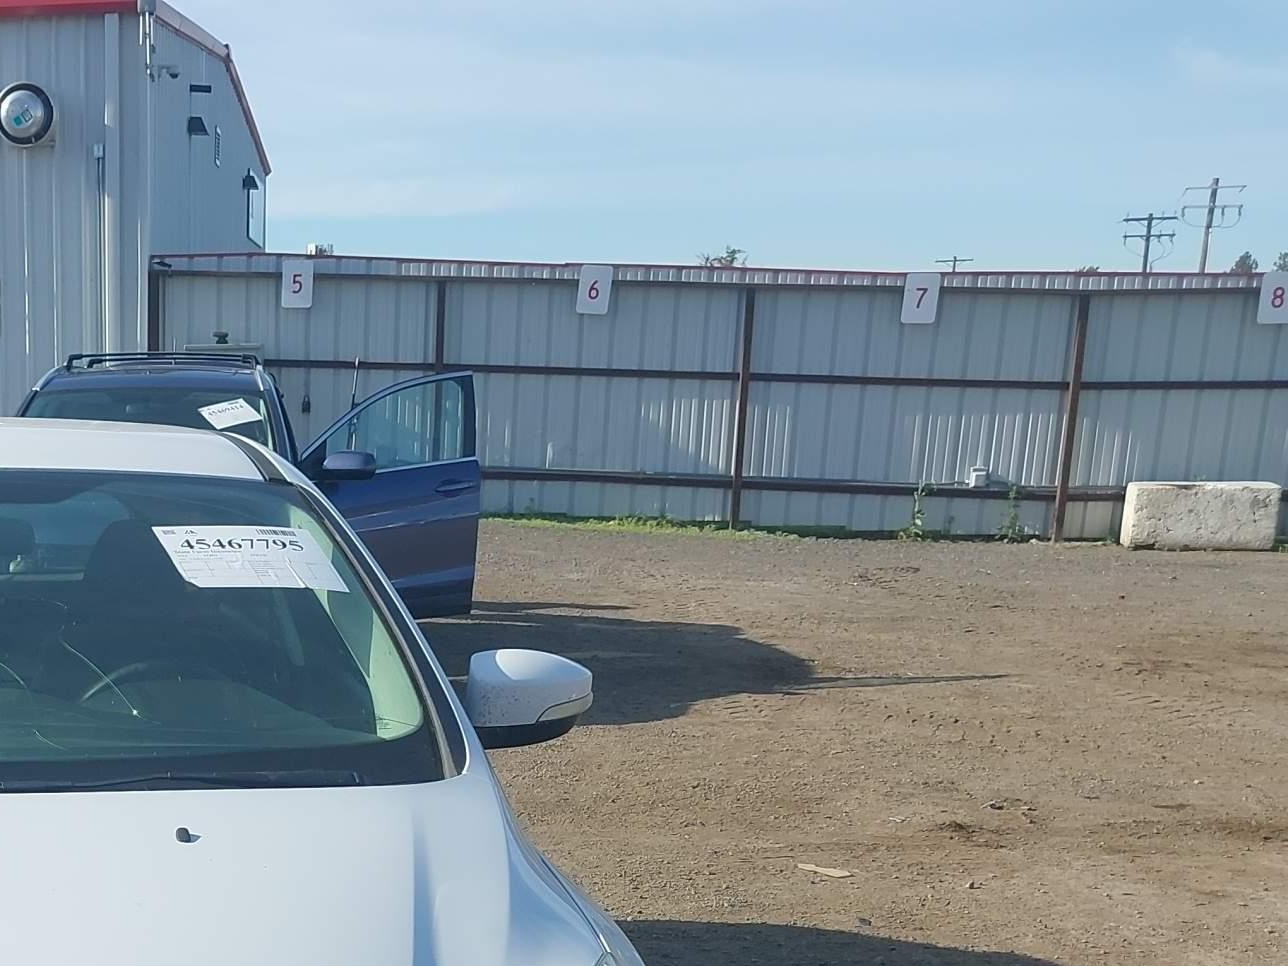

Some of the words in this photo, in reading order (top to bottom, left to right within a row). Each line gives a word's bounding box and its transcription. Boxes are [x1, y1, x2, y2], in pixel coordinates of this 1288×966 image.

[292, 273, 303, 294] 5
[588, 279, 600, 300] 6
[915, 287, 929, 309] 7
[1271, 286, 1286, 308] 8
[180, 538, 304, 552] 45467795
